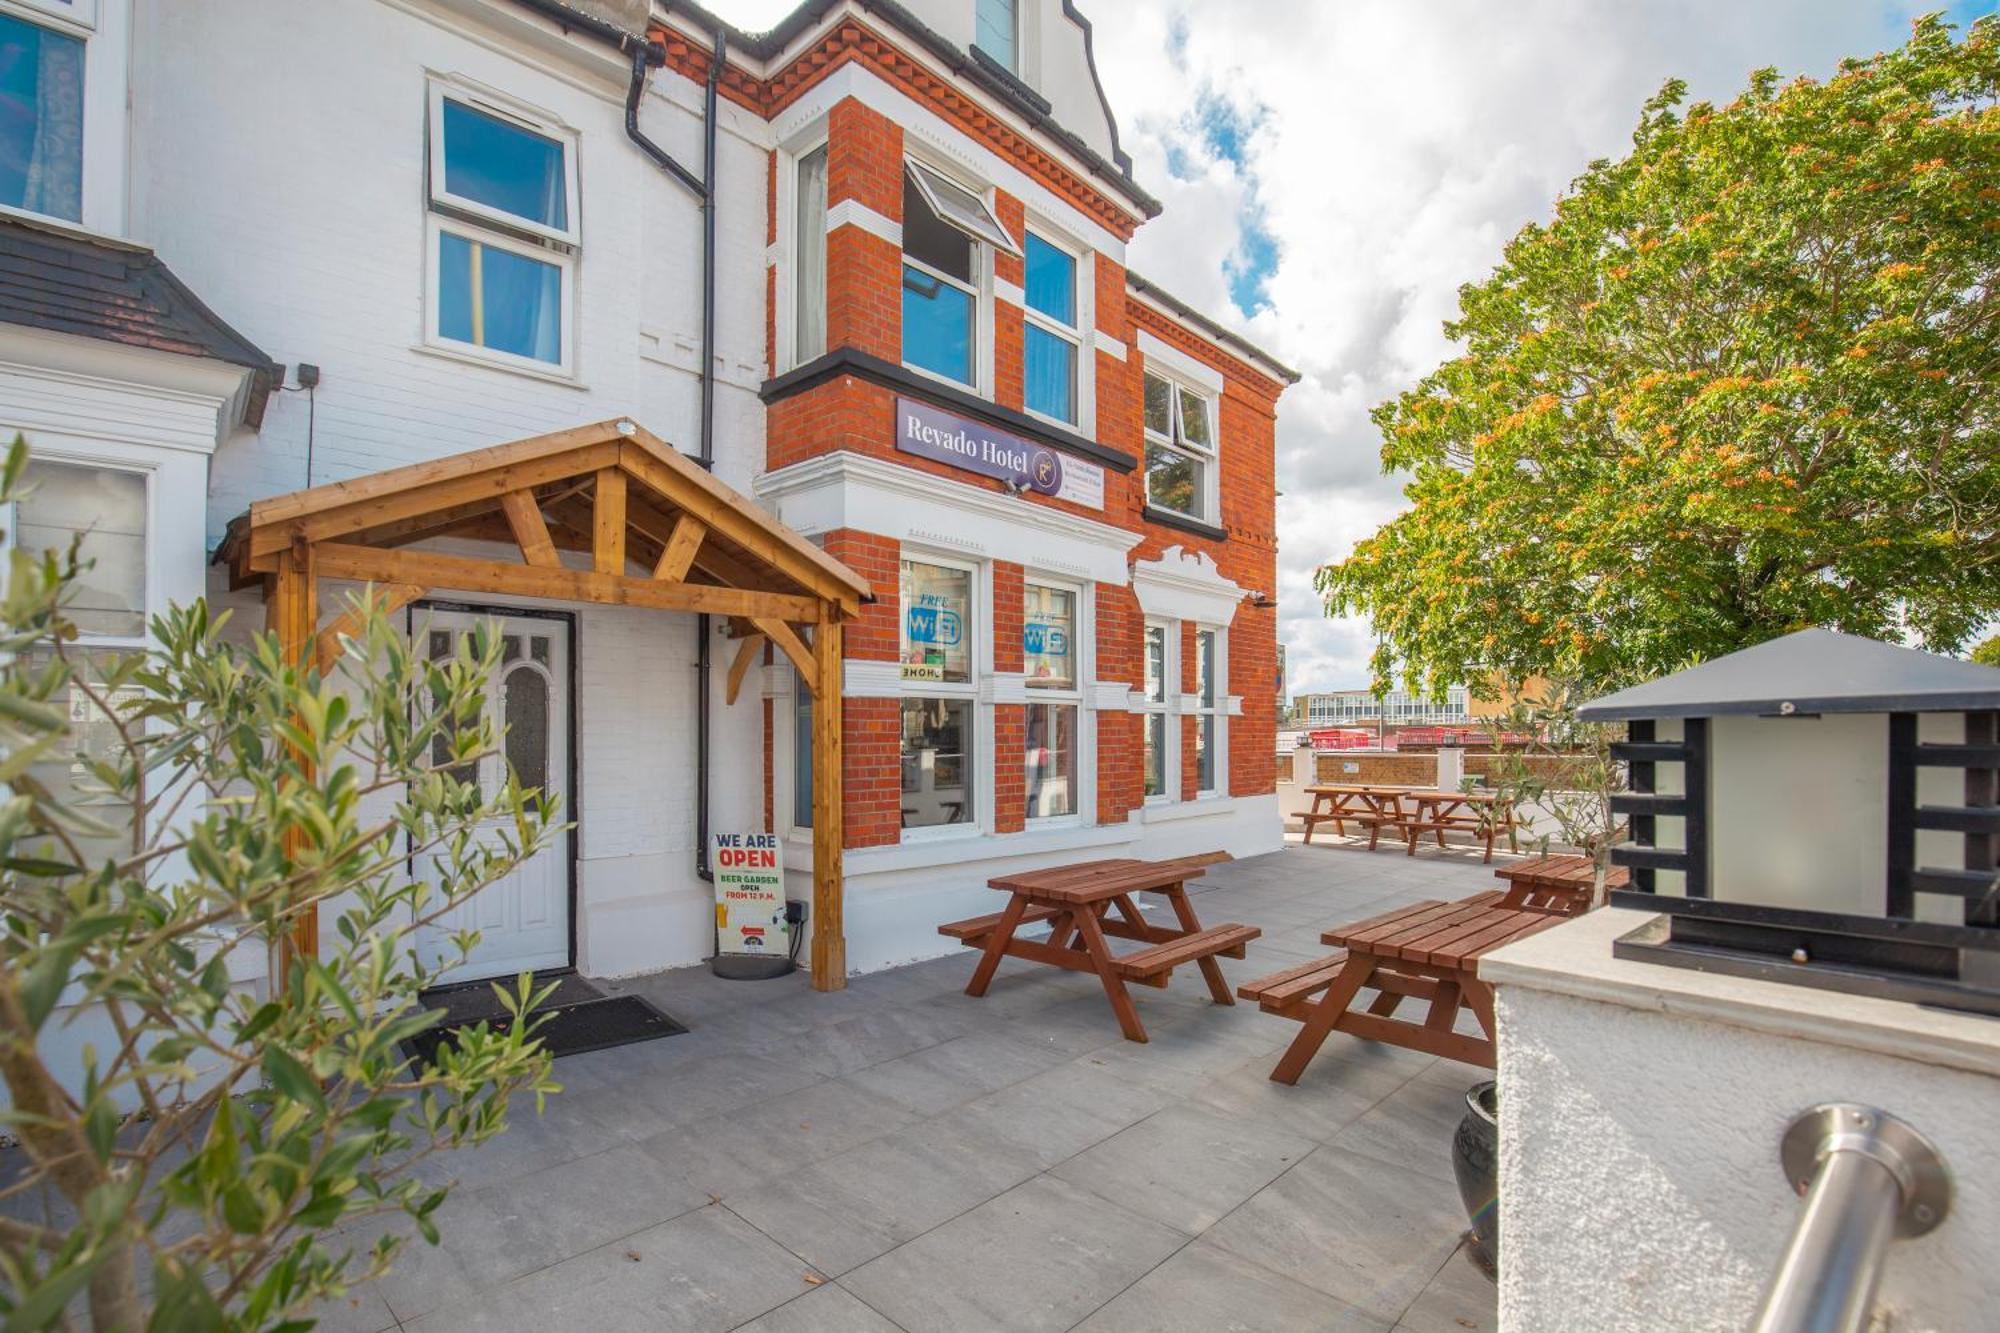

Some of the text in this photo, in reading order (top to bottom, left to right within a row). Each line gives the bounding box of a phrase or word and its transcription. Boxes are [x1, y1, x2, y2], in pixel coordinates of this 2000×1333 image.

[907, 415, 977, 457] Revado
[982, 439, 1028, 474] Hotel
[716, 834, 776, 848] WE ARE
[719, 849, 776, 867] OPEN
[720, 875, 779, 885] BEER GARDEN
[726, 891, 748, 900] FROM
